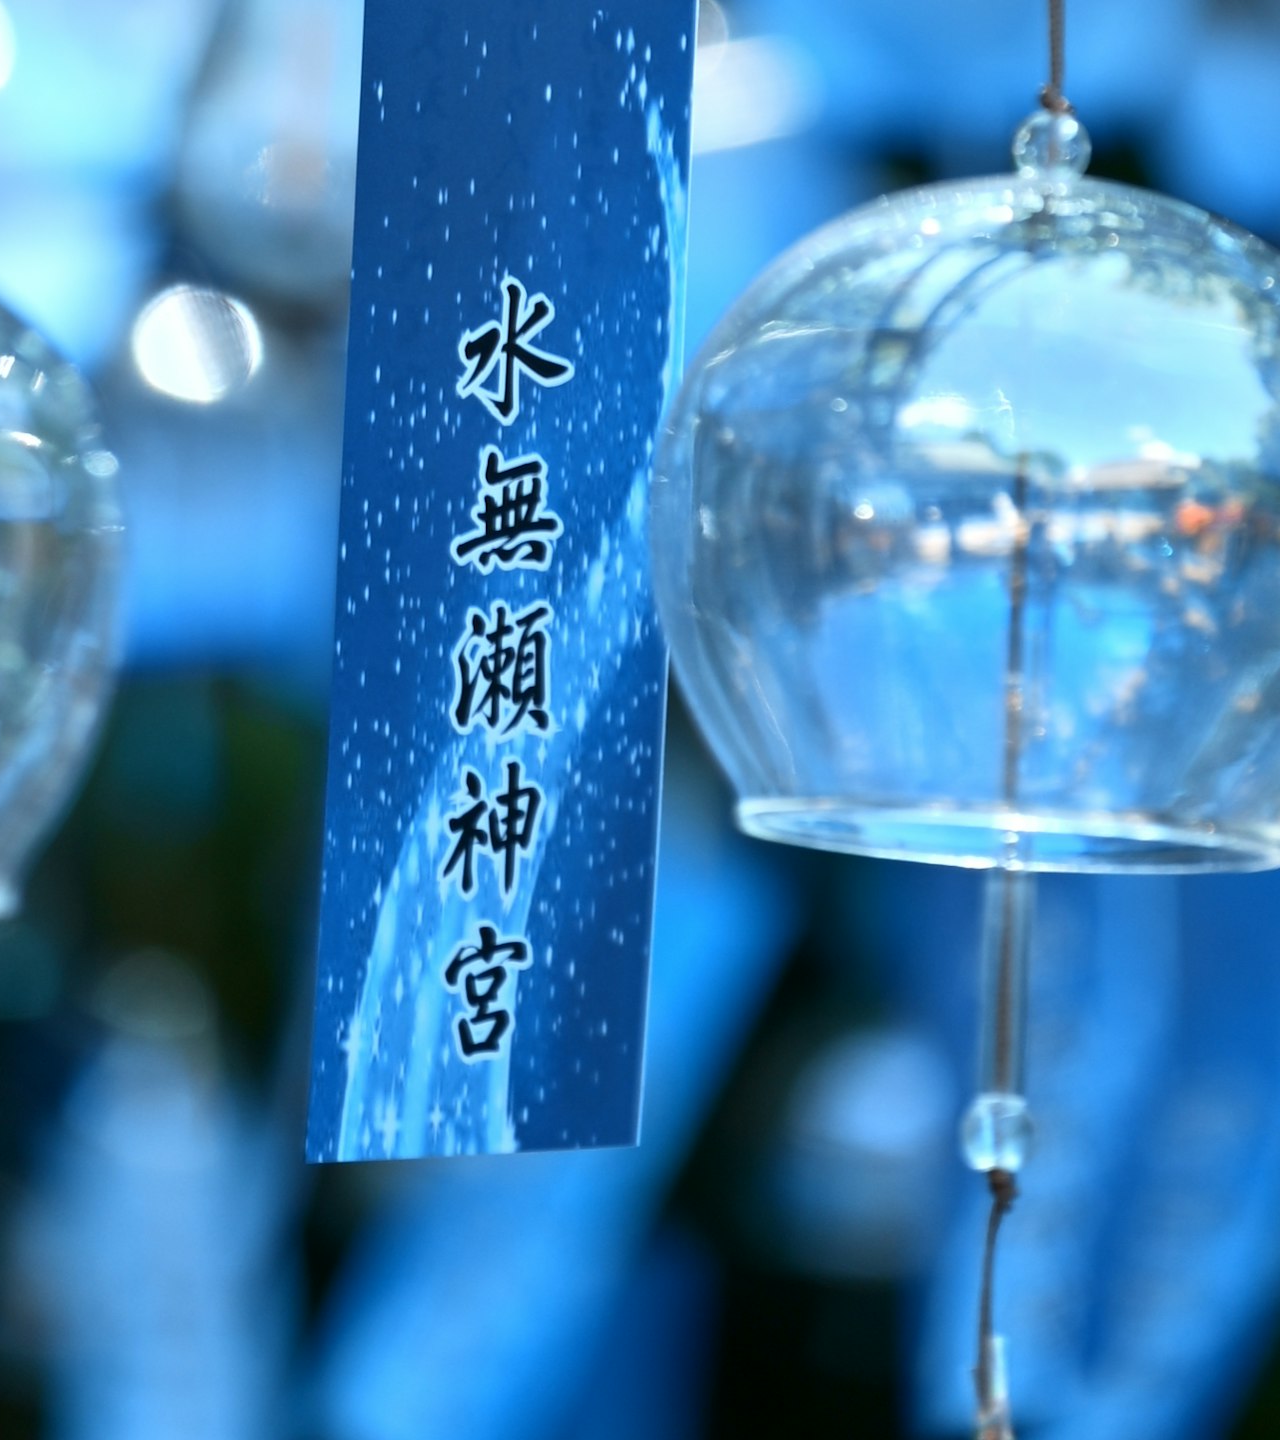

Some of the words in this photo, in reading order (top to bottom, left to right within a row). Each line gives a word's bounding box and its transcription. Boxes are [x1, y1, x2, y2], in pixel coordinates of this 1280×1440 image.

[443, 281, 572, 1058] 水無瀬神宮
